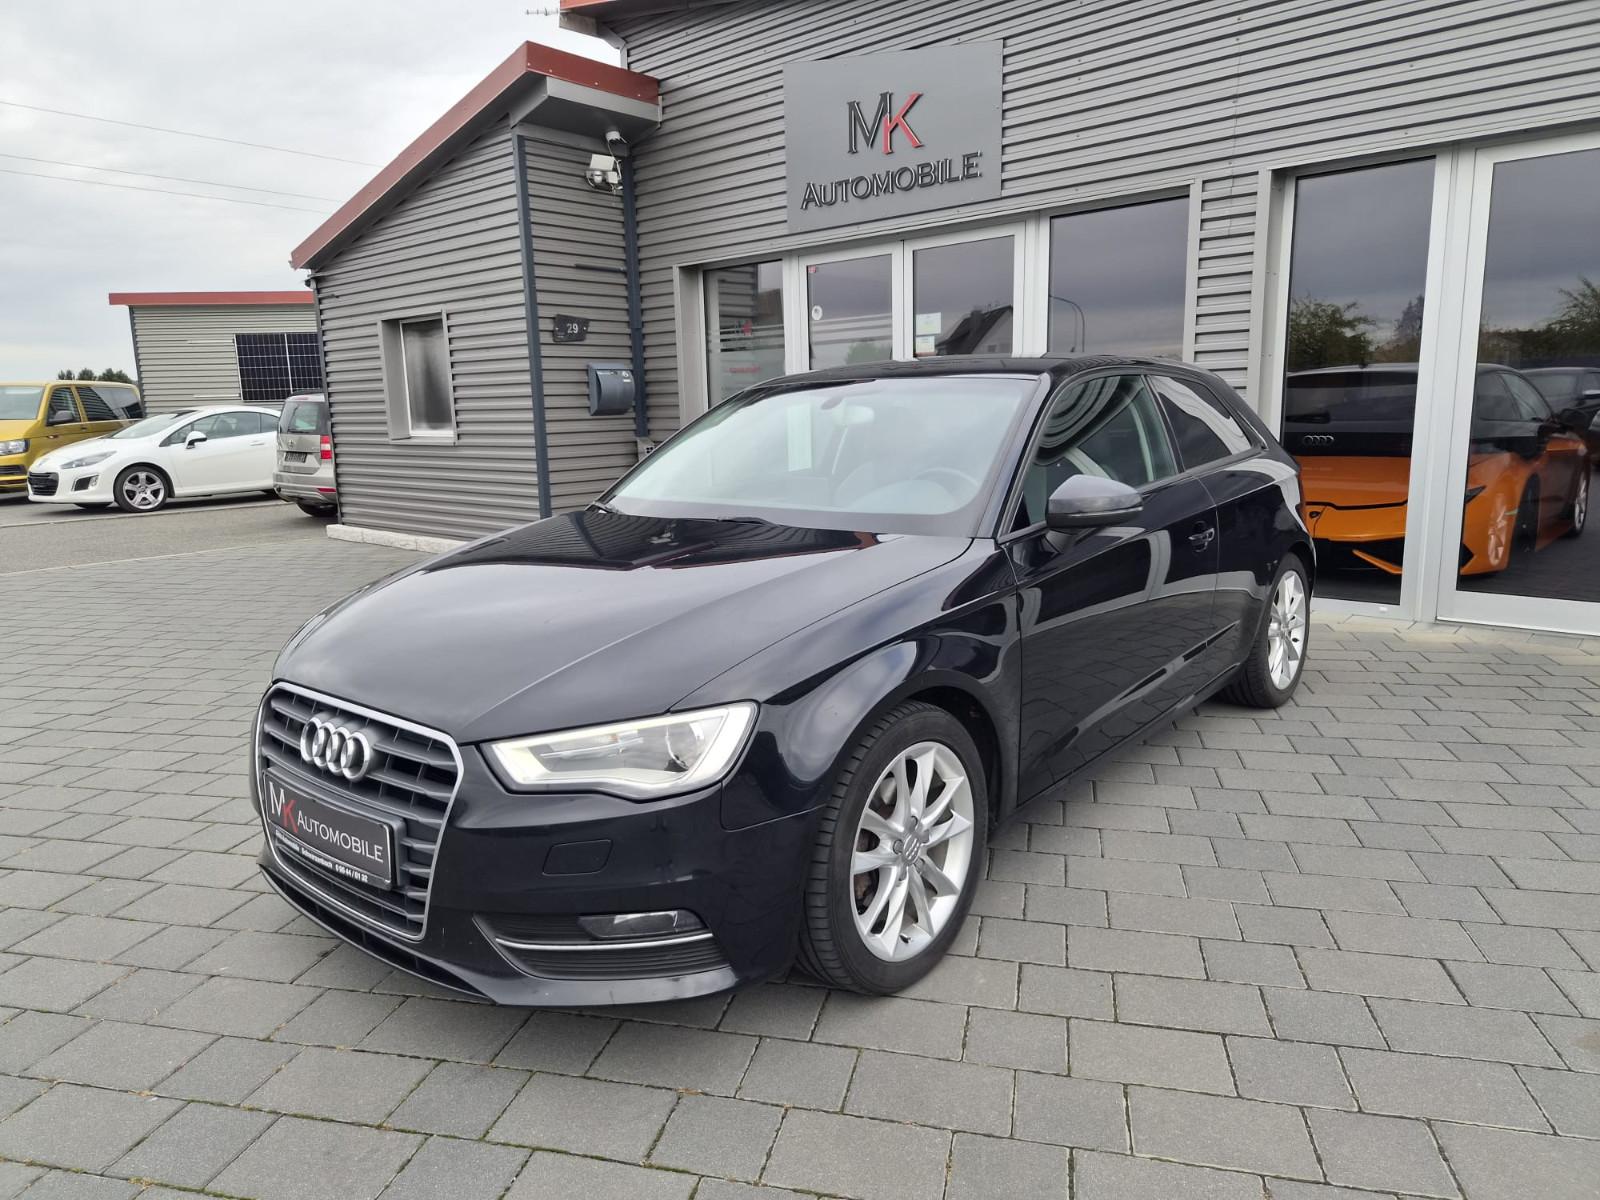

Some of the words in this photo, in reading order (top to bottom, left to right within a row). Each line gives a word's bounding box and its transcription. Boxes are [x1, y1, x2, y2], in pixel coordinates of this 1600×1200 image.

[847, 90, 924, 155] MK
[800, 150, 982, 210] AUTOMOBILE
[269, 781, 298, 833] MK
[297, 810, 384, 863] AUTOMOBILE
